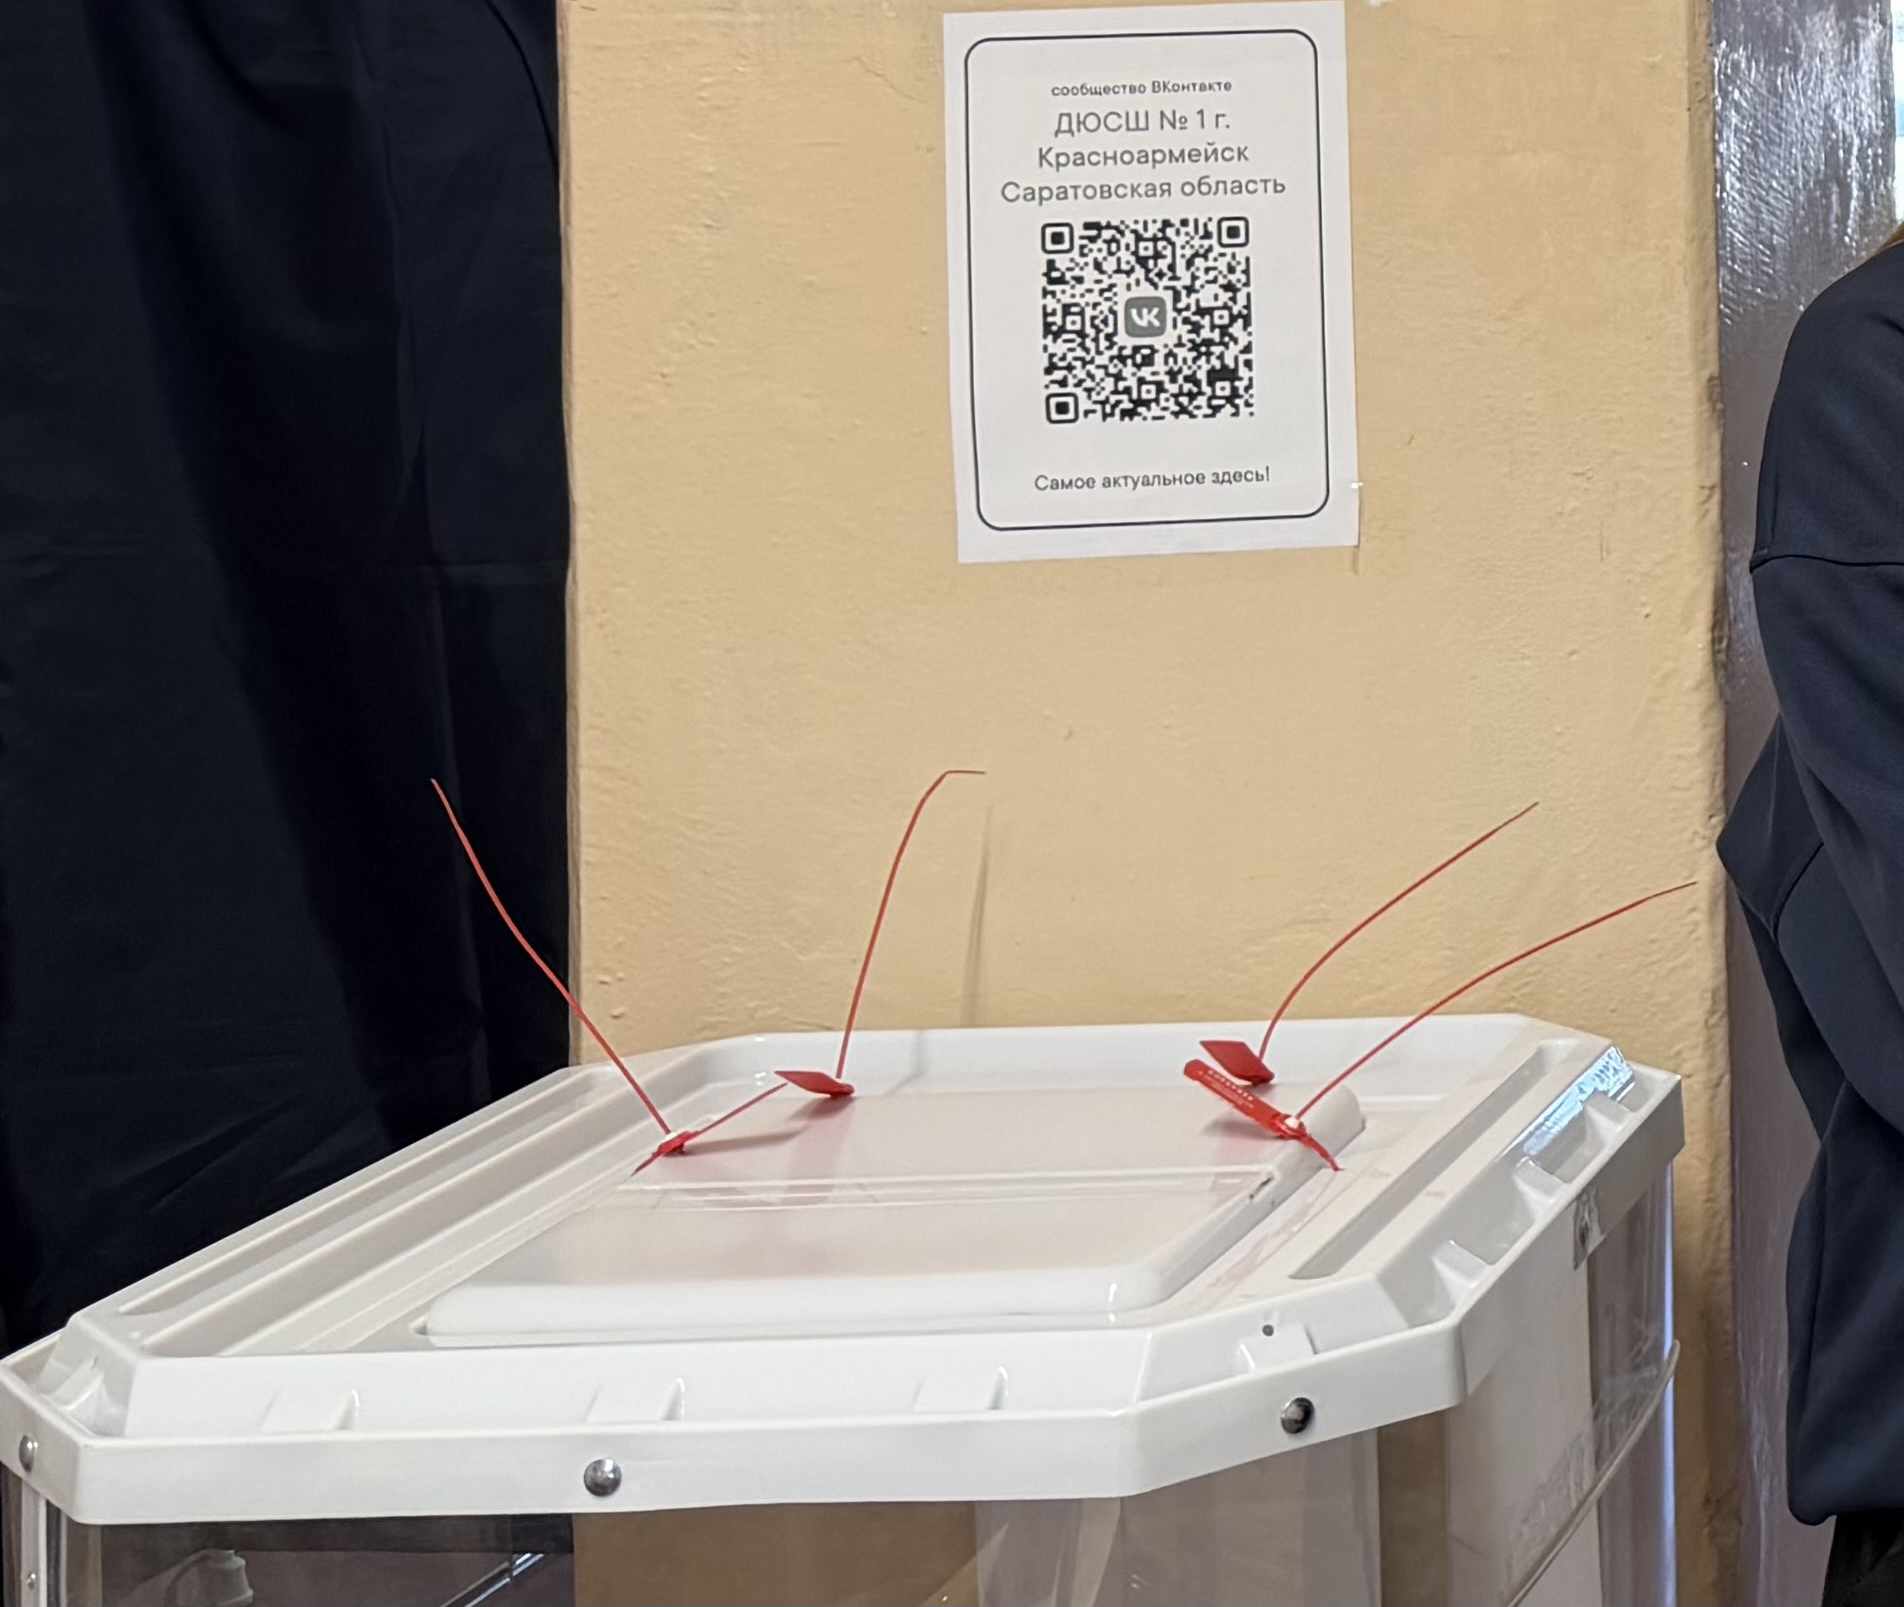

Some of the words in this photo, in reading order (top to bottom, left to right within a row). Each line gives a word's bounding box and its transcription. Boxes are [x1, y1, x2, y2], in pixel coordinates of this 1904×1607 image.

[1051, 81, 1146, 96] сообщество
[1151, 79, 1232, 94] ВКонтакте
[1055, 112, 1149, 137] ДЮСШ
[1160, 110, 1188, 132] №
[1197, 109, 1206, 130] 1
[1215, 112, 1231, 130] г.
[1038, 142, 1249, 169] Красноармейск
[1001, 180, 1172, 206] Саратовская
[1181, 176, 1286, 197] область
[1035, 475, 1095, 492] Самое
[1102, 470, 1206, 491] актуальное
[1211, 466, 1270, 485] здесь!
